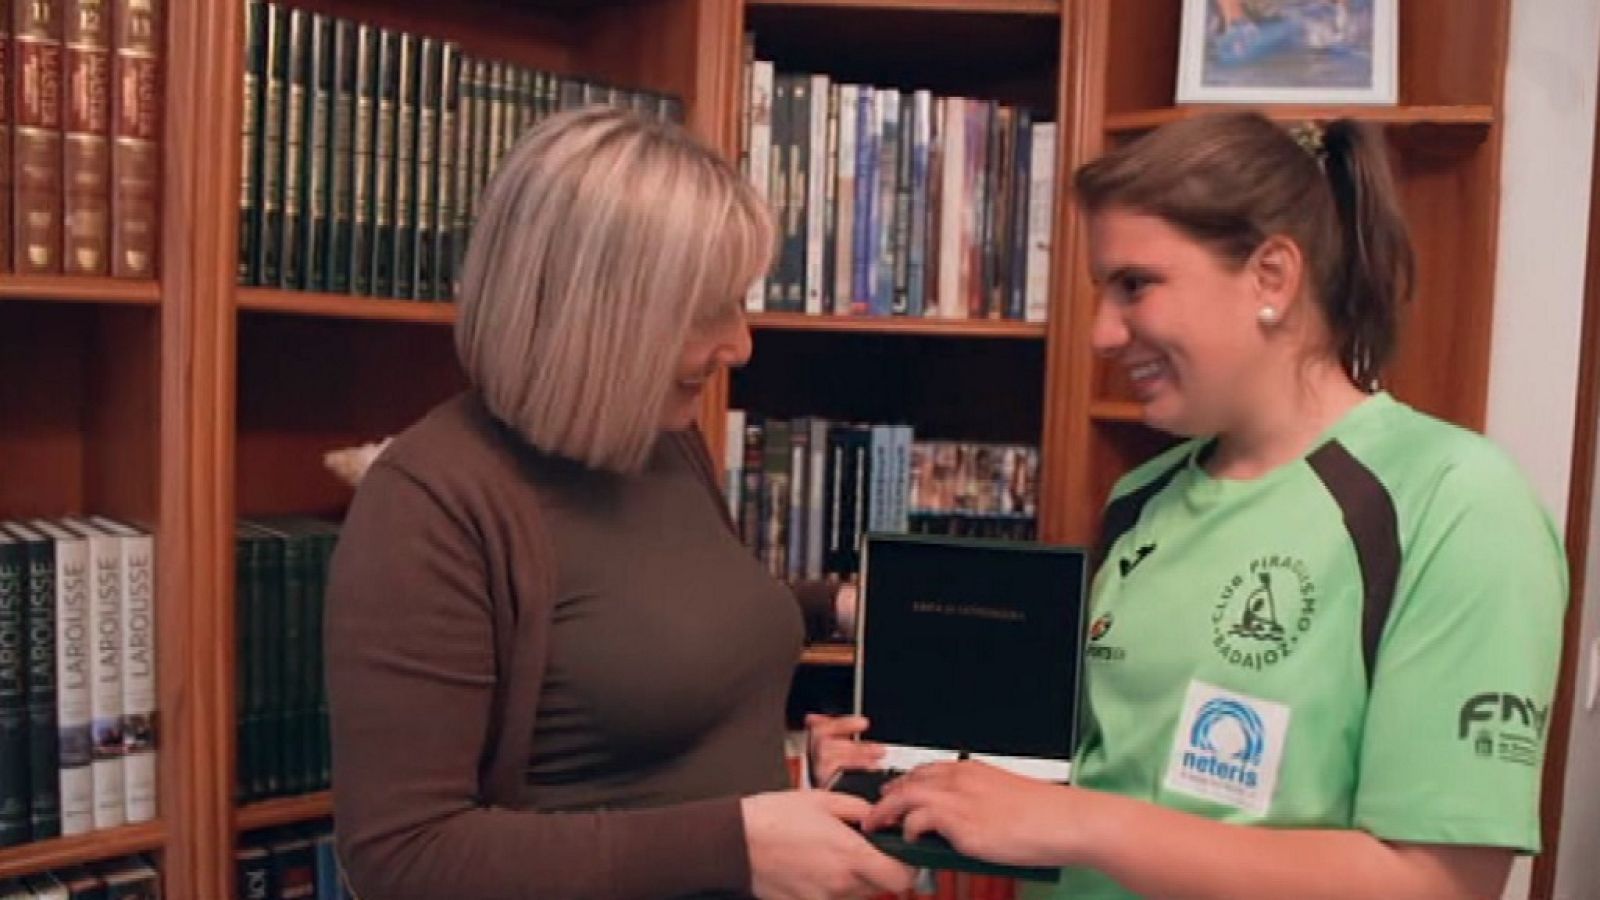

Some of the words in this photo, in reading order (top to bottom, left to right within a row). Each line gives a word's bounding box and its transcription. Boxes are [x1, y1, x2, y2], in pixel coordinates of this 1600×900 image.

[30, 560, 53, 692] LAROUSSE
[63, 561, 86, 690] LAROUSSE
[97, 556, 120, 683] LAROUSSE
[129, 553, 151, 677] LAROUSSE
[1183, 750, 1258, 788] neteris
